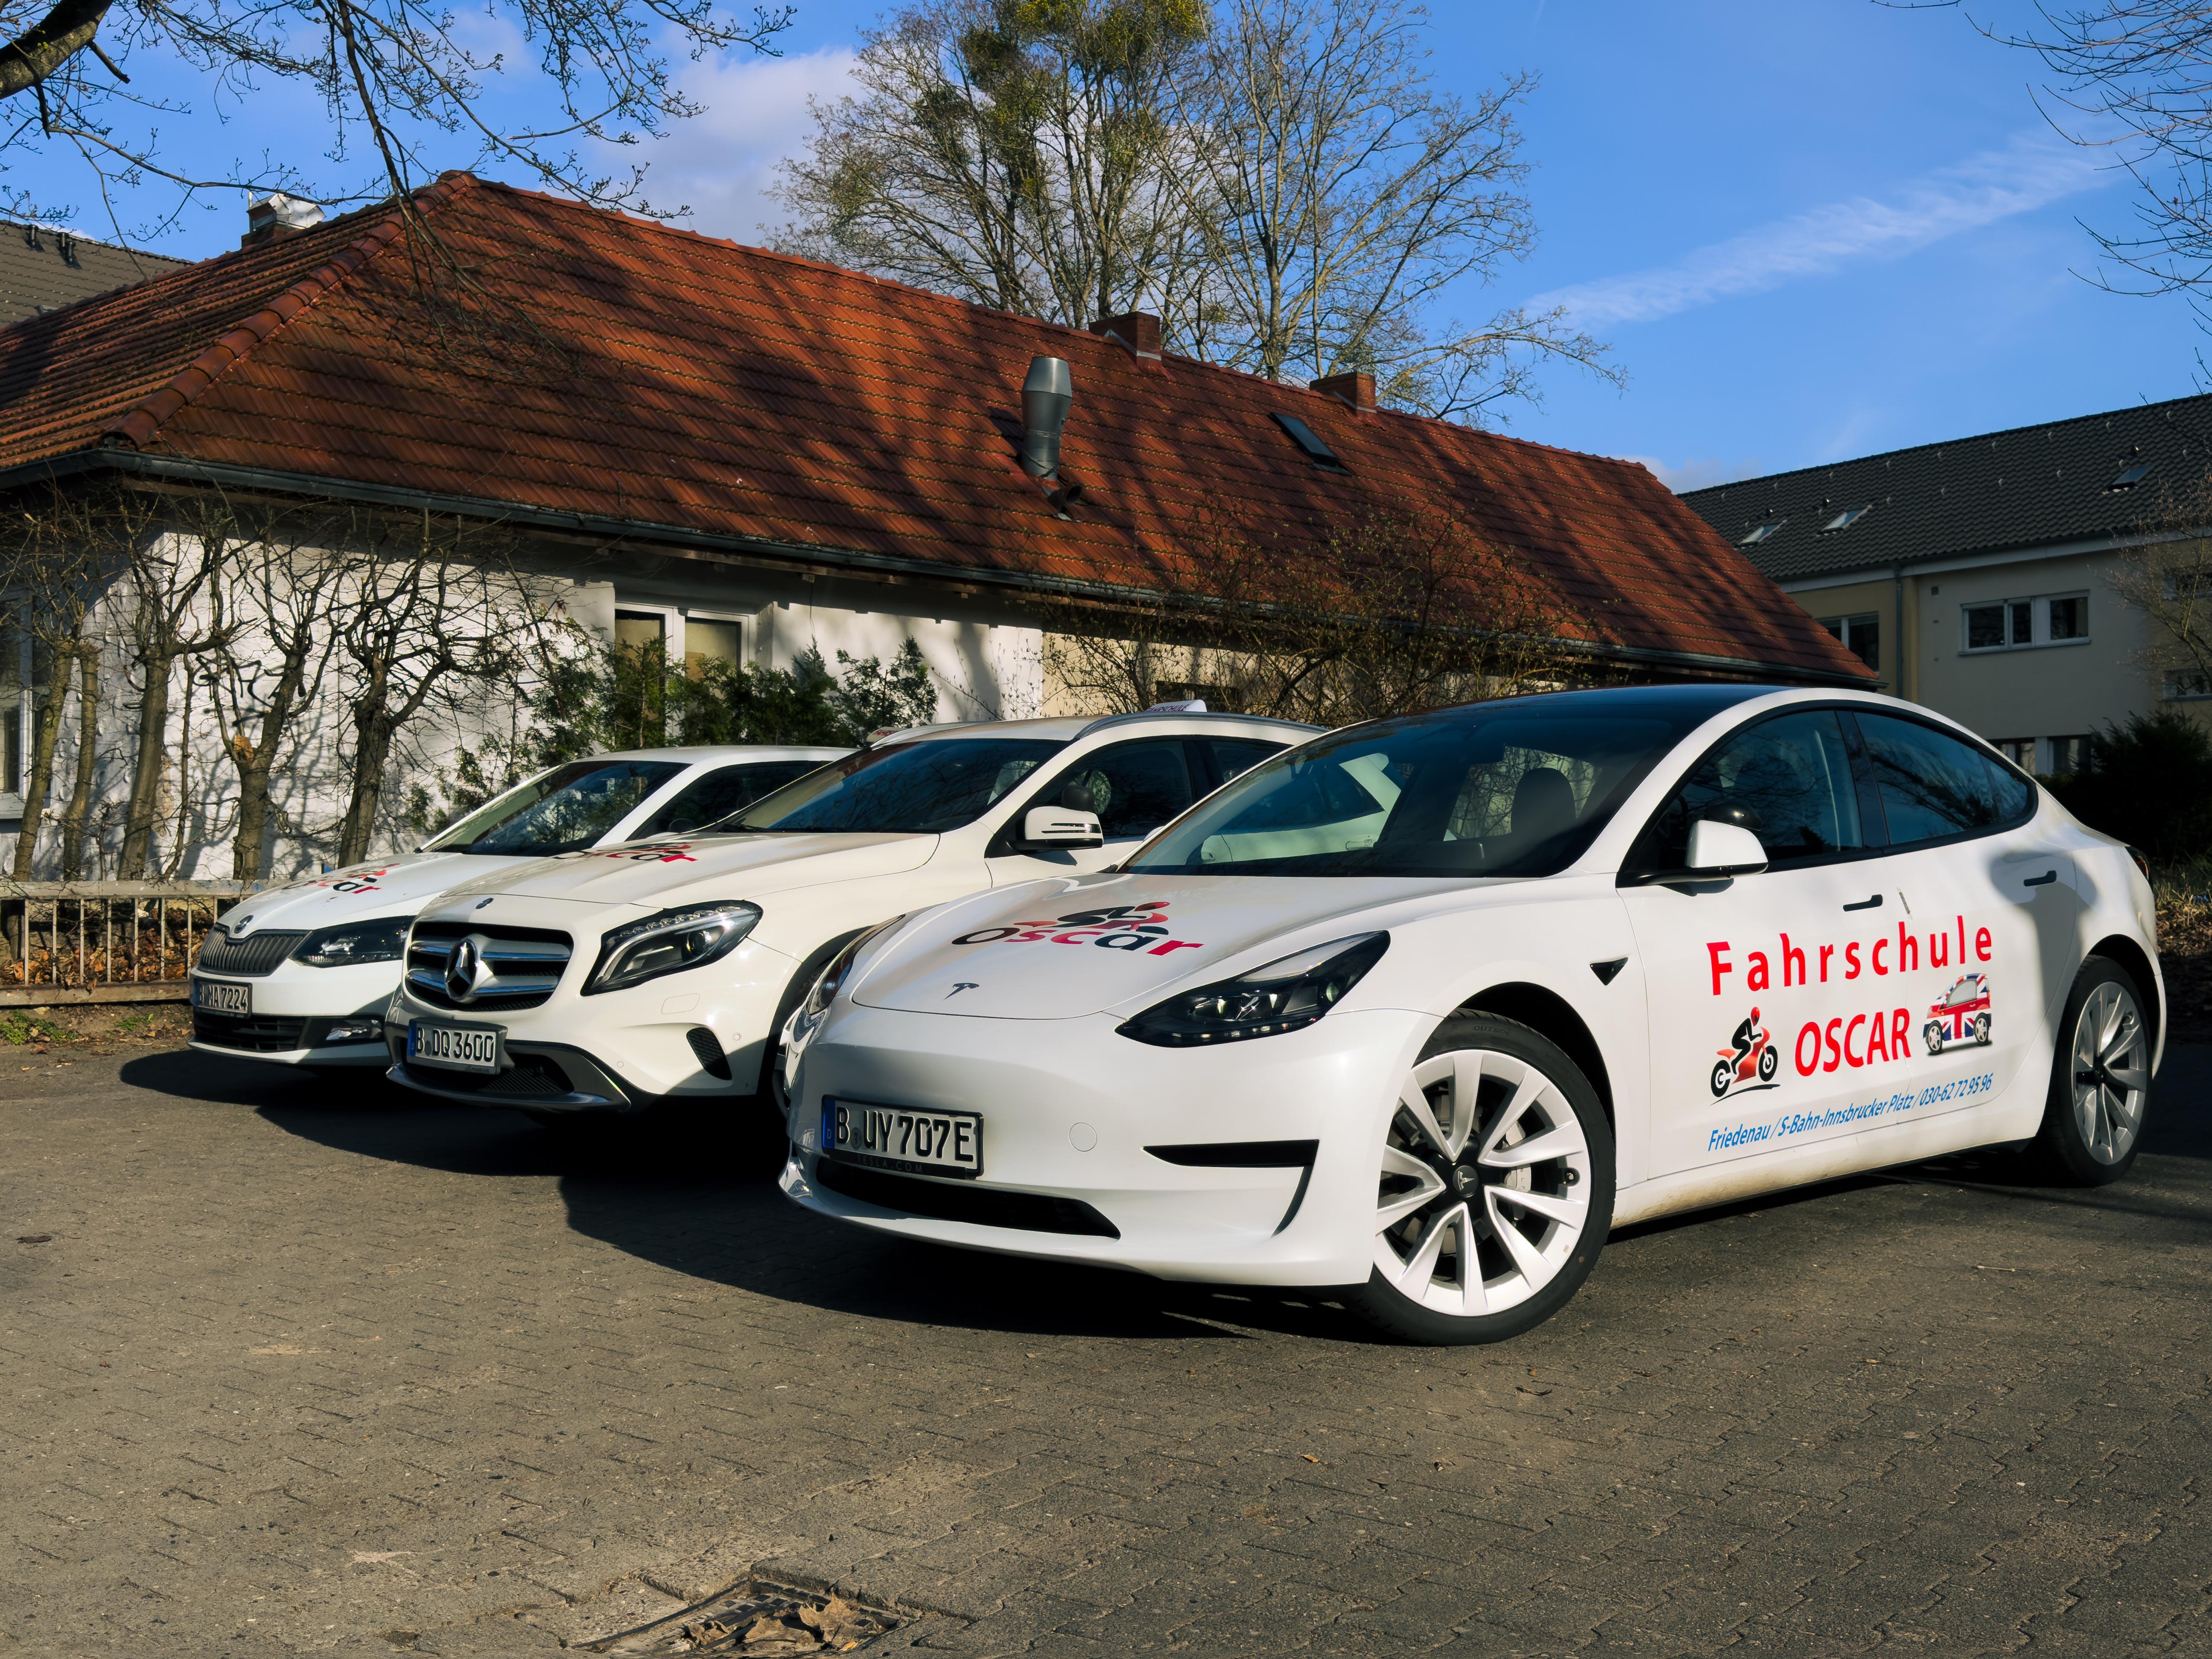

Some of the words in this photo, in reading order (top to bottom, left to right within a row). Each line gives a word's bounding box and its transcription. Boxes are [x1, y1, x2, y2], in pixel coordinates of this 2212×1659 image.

[951, 927, 1205, 956] oscar
[1706, 915, 1992, 996] Fahrschule
[221, 986, 248, 1011] 7224
[417, 1027, 425, 1053] B
[432, 1029, 451, 1058] DQ
[454, 1032, 495, 1062] 3600
[1474, 1025, 1511, 1035] OUTSIDE
[1795, 1008, 1911, 1077] OSCAR
[836, 1106, 850, 1144] B
[897, 1114, 974, 1162] 707E
[1707, 1123, 1771, 1152] Friedenau
[1778, 1098, 1889, 1137] S-Bahn-Innsbrucker
[1886, 1092, 1915, 1113] Platz
[857, 1155, 923, 1173] TESLA.COM
